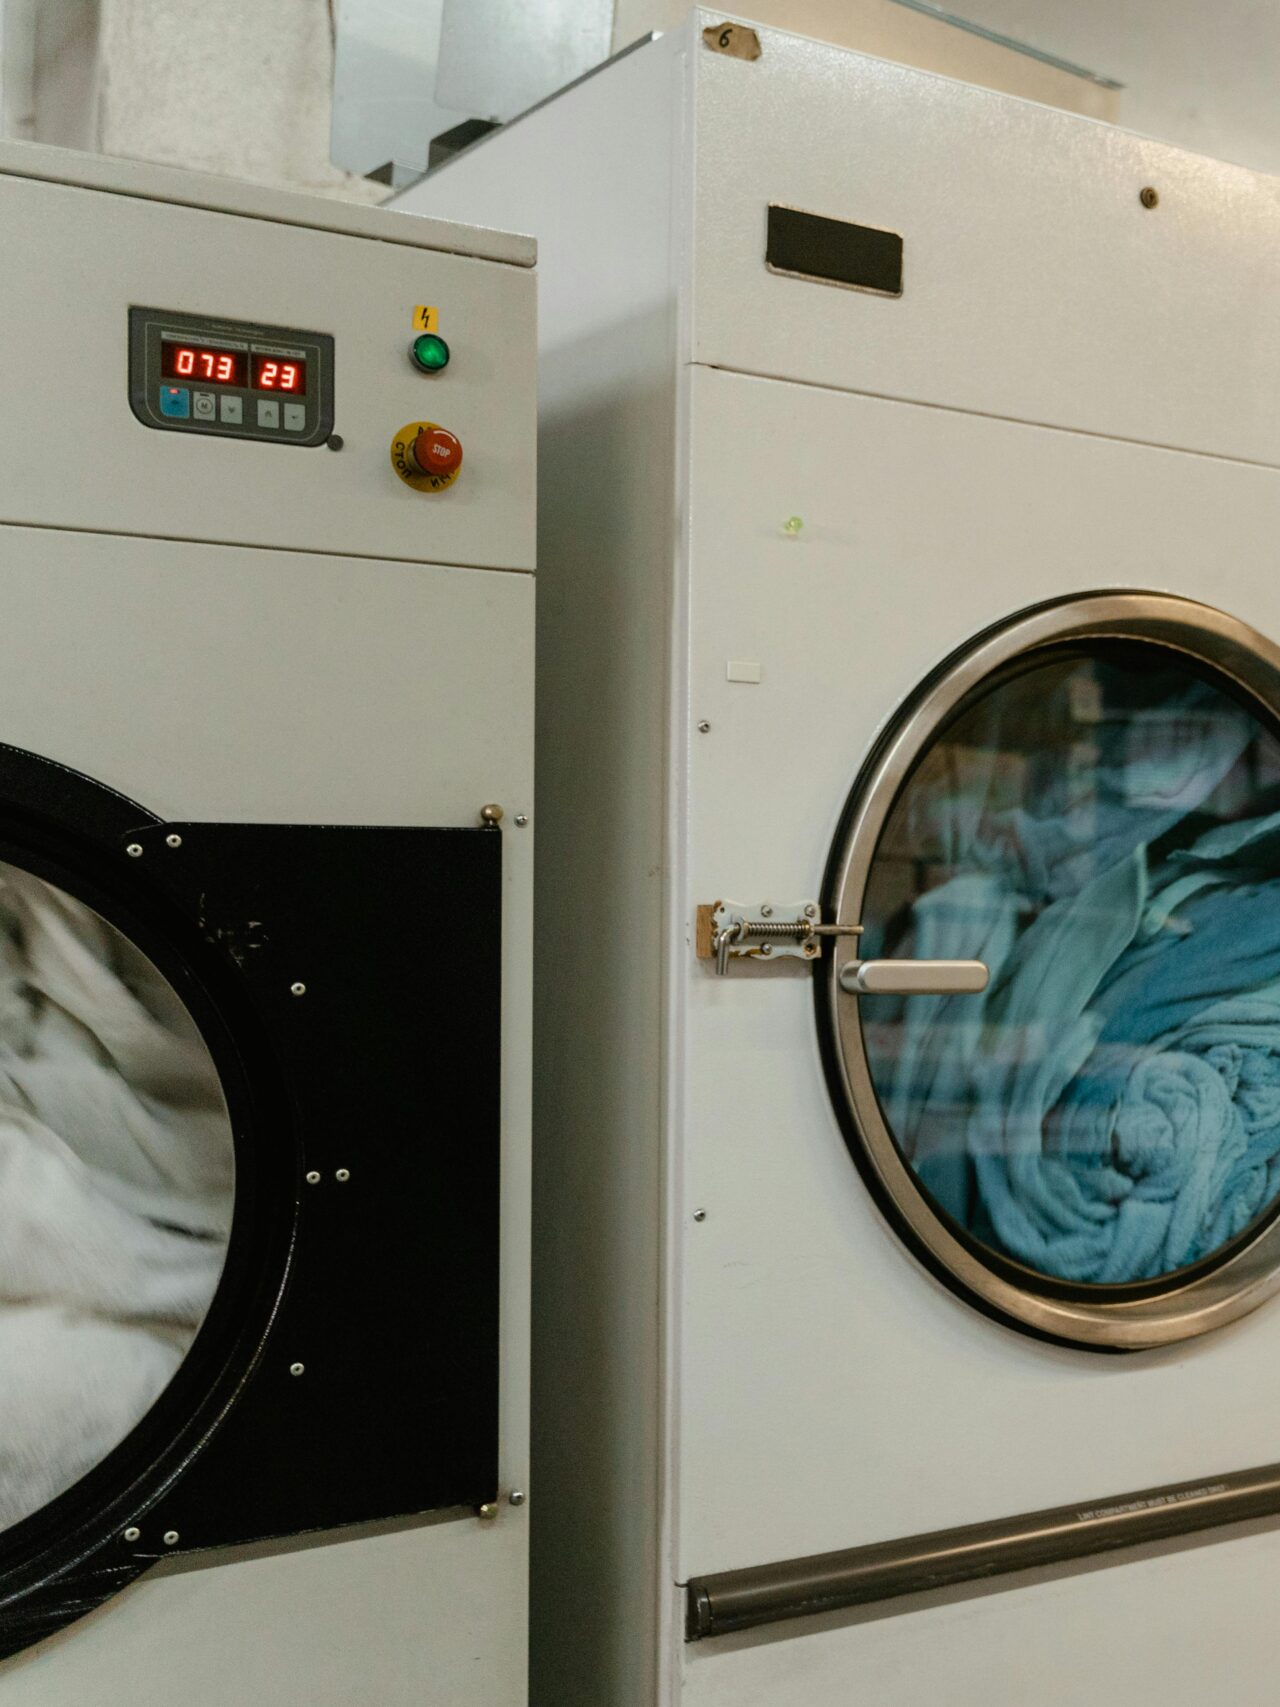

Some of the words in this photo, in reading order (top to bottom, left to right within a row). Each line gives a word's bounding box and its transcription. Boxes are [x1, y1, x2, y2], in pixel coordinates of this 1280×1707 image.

[718, 28, 733, 48] 6
[176, 350, 233, 381] 073
[260, 363, 297, 388] 23
[394, 441, 413, 479] СТОП
[432, 443, 451, 458] STOP
